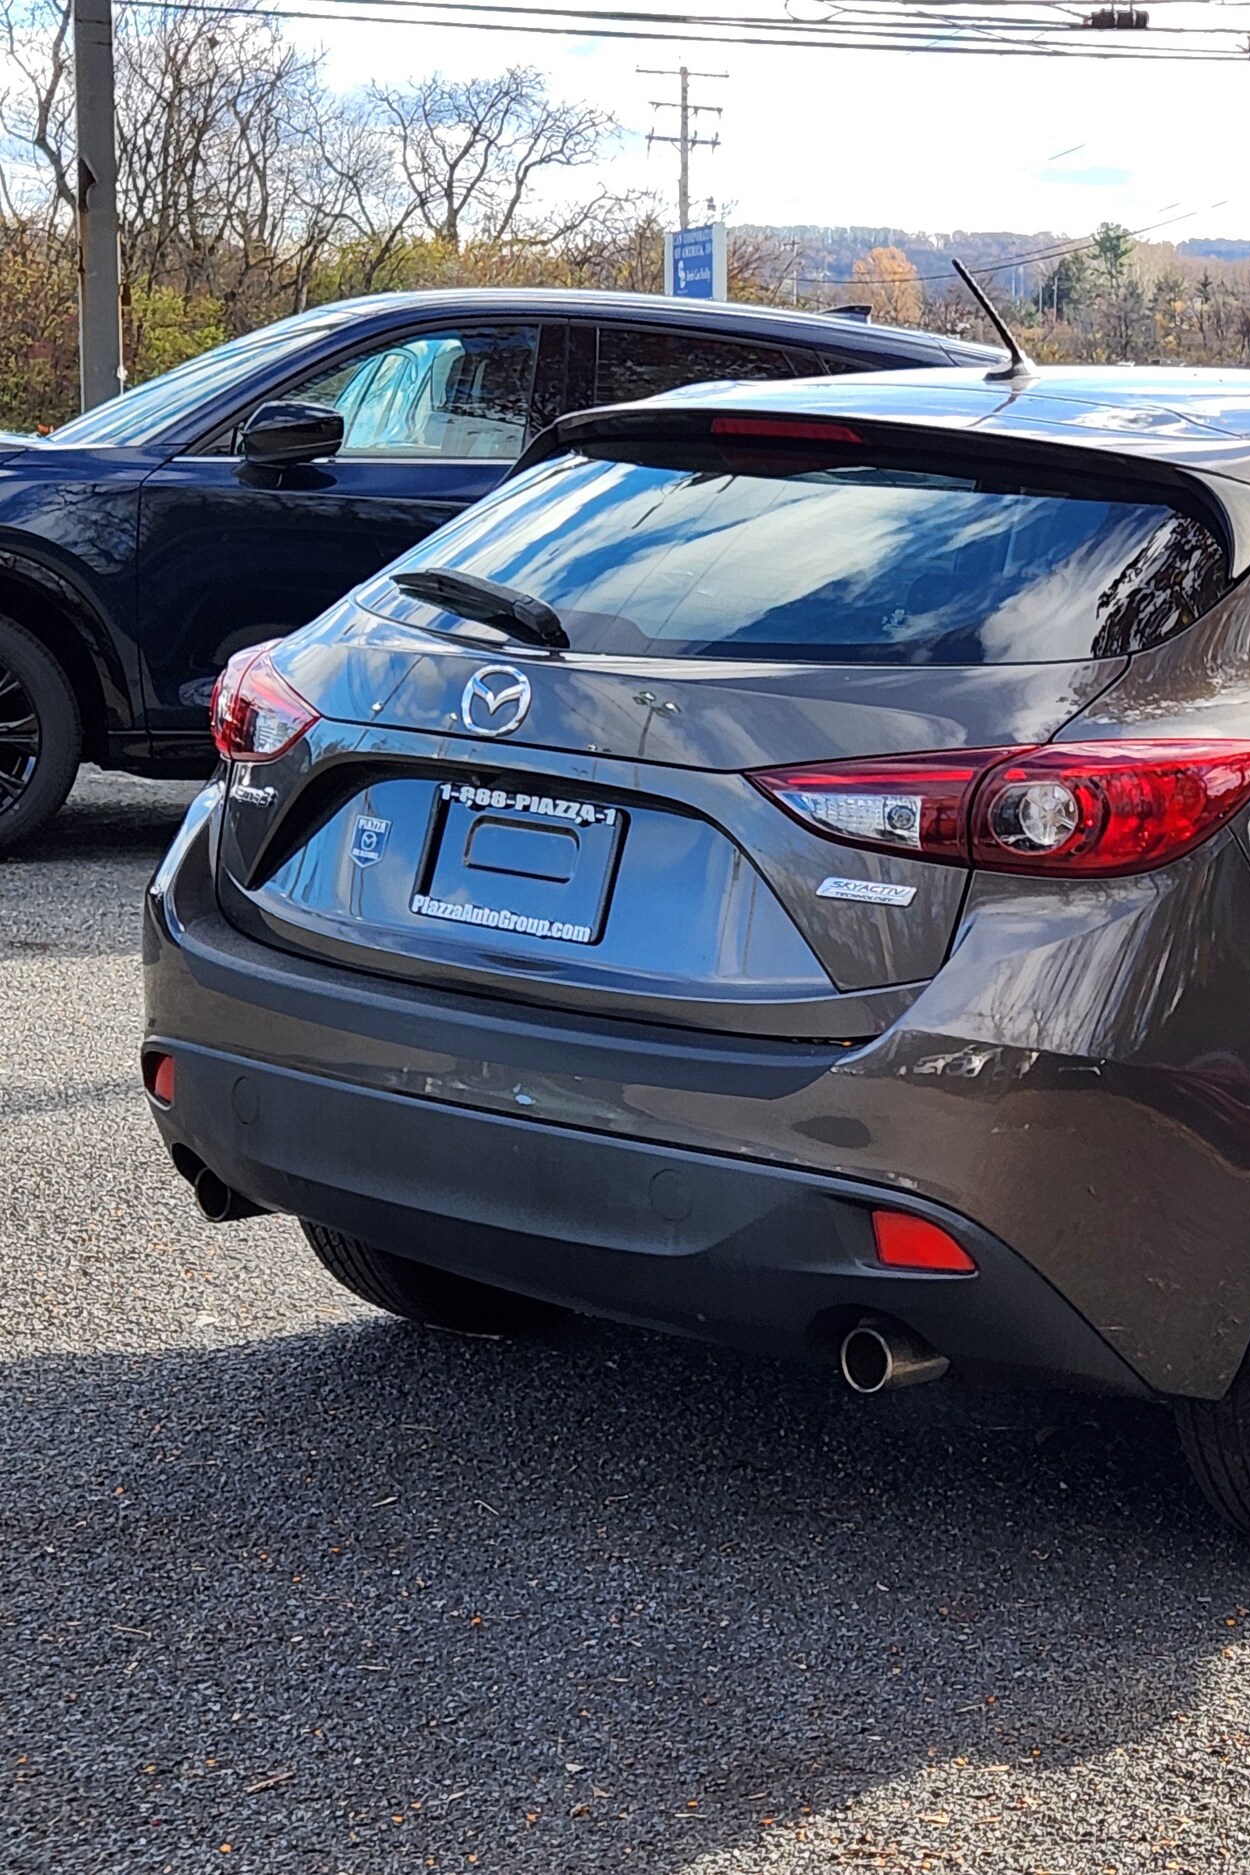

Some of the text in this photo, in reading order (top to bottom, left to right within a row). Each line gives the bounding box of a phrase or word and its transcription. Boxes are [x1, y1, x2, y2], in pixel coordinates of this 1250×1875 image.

[440, 783, 617, 826] 1-888-PIAZZA-1
[829, 880, 905, 896] SKYACTIV
[411, 894, 591, 943] PiazzaAutoGroup.com
